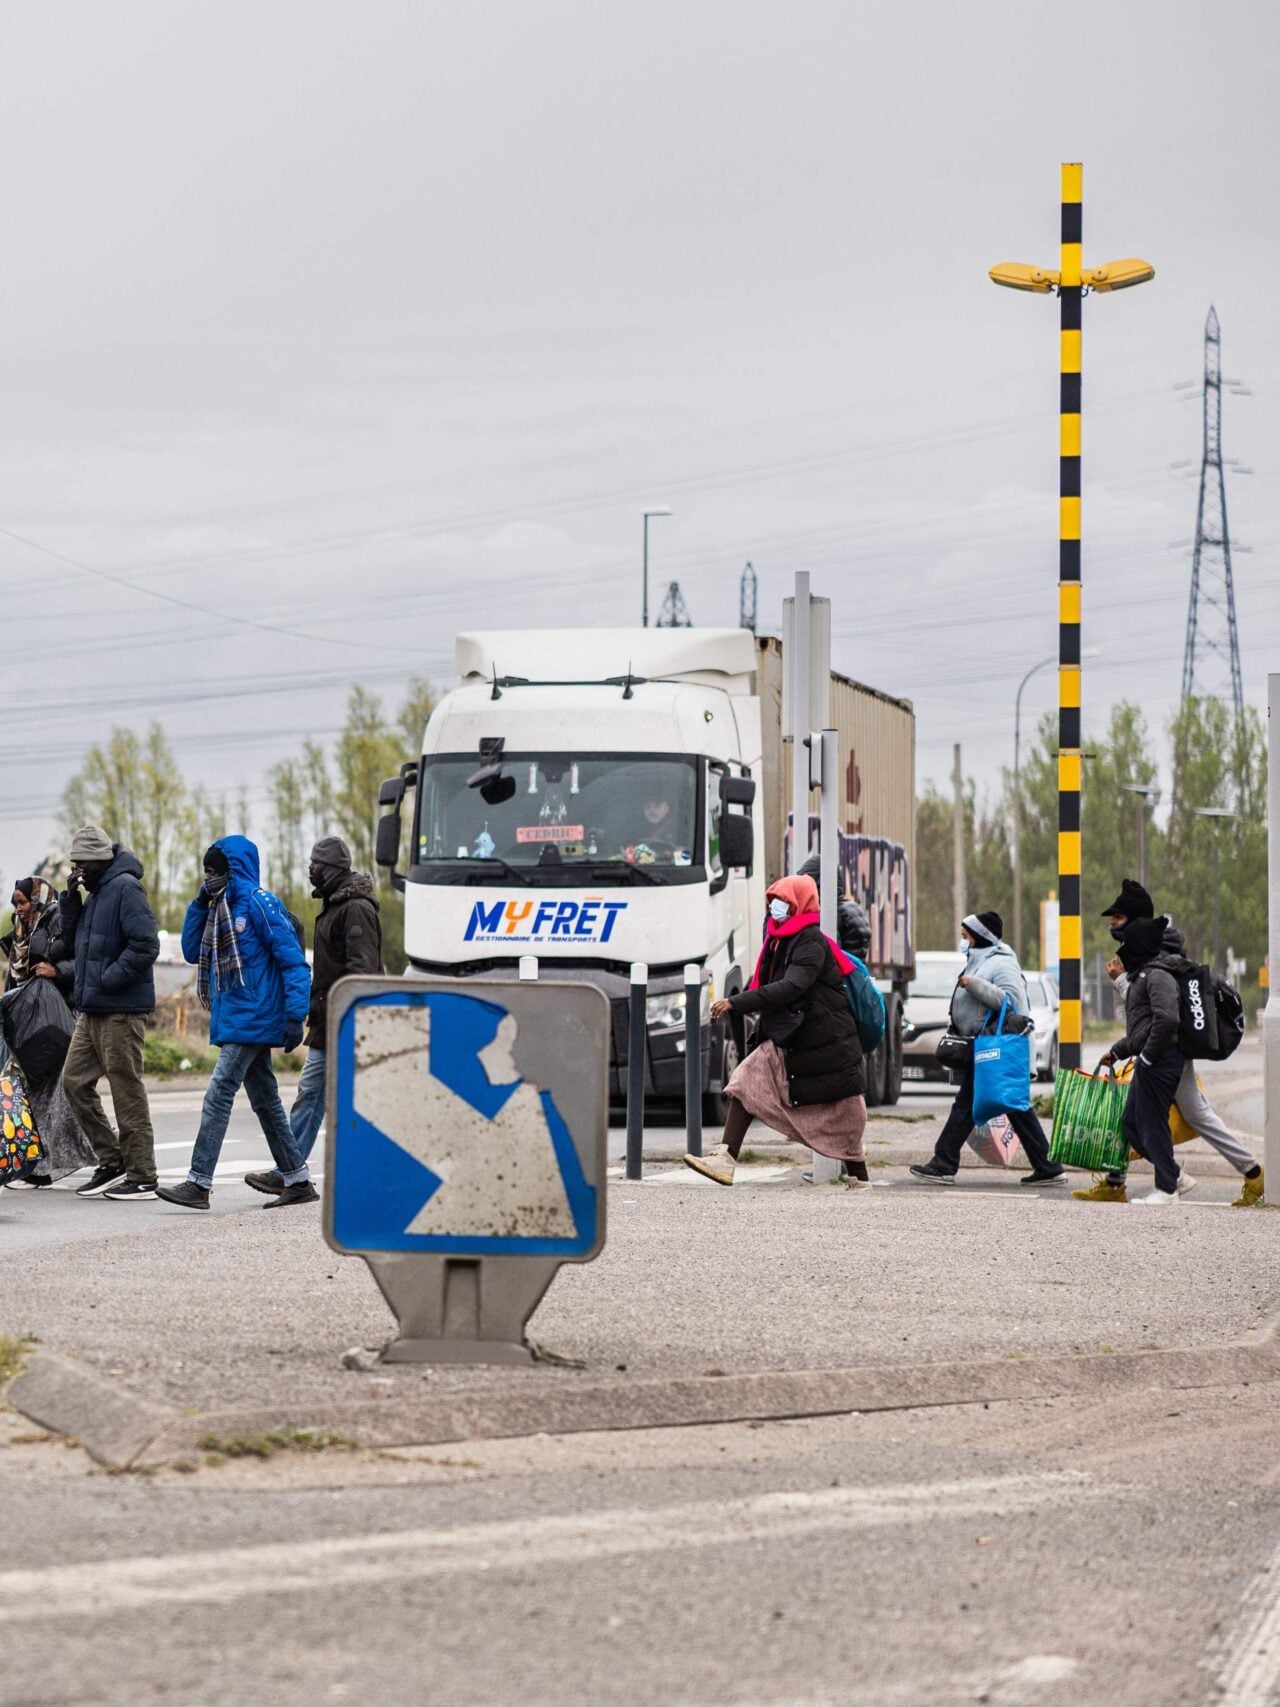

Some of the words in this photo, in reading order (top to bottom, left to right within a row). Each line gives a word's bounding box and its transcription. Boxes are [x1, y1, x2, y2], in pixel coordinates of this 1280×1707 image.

[526, 827, 574, 840] CEDRIC
[463, 901, 534, 941] MY
[1188, 979, 1205, 1030] adidas
